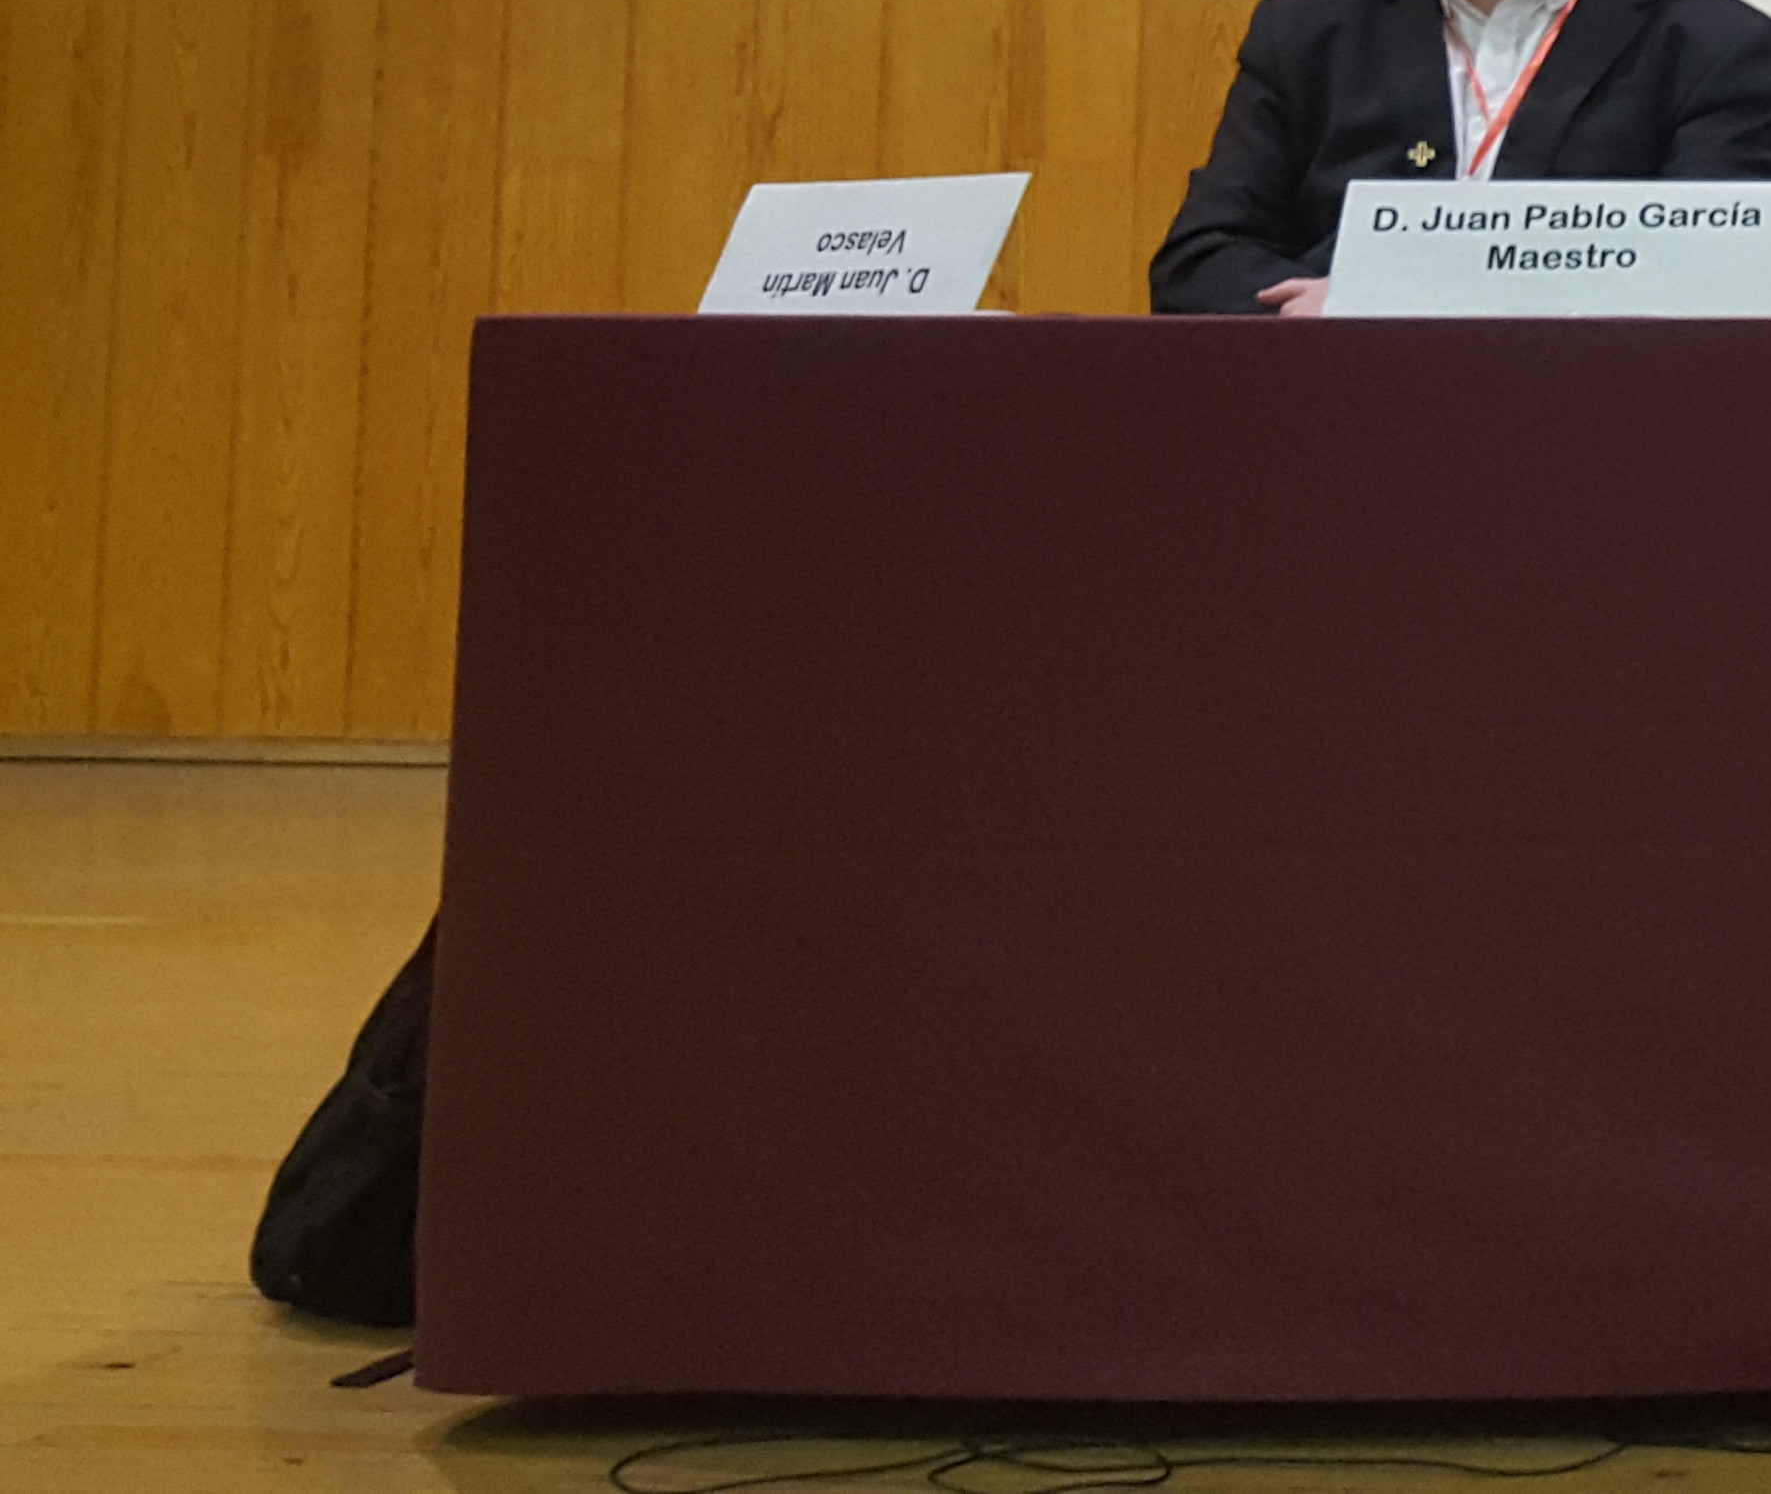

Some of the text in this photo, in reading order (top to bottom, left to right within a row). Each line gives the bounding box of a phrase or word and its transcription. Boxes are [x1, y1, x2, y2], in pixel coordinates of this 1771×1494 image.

[1373, 202, 1760, 231] D. Juan Pablo García
[817, 230, 906, 255] Velasco
[1488, 244, 1636, 269] Maestro
[763, 268, 930, 298] D. Juan Martín
